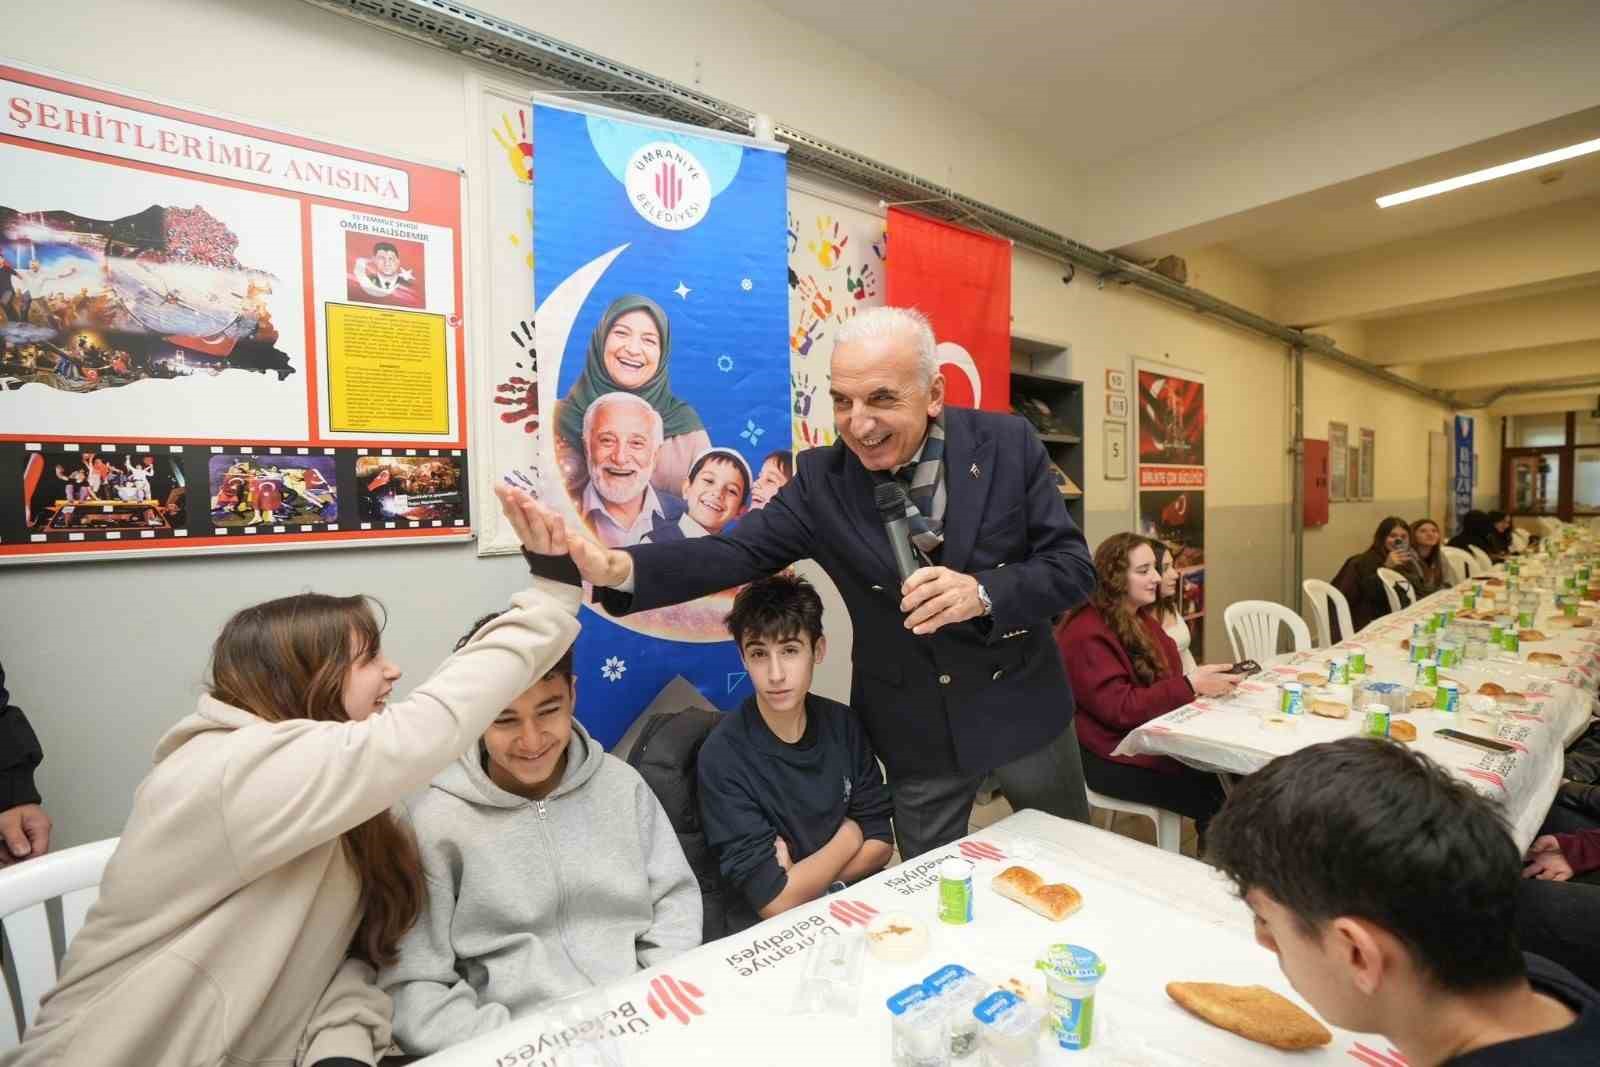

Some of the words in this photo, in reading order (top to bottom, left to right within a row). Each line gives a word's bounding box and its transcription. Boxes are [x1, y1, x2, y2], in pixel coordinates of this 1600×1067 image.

[8, 95, 272, 176] ŞEHİTLERİMİZ
[281, 157, 402, 200] ANISINA
[635, 147, 701, 180] ÜMRANİYE
[636, 192, 701, 223] BELEDİYESİ
[725, 915, 826, 970] Belediyesi
